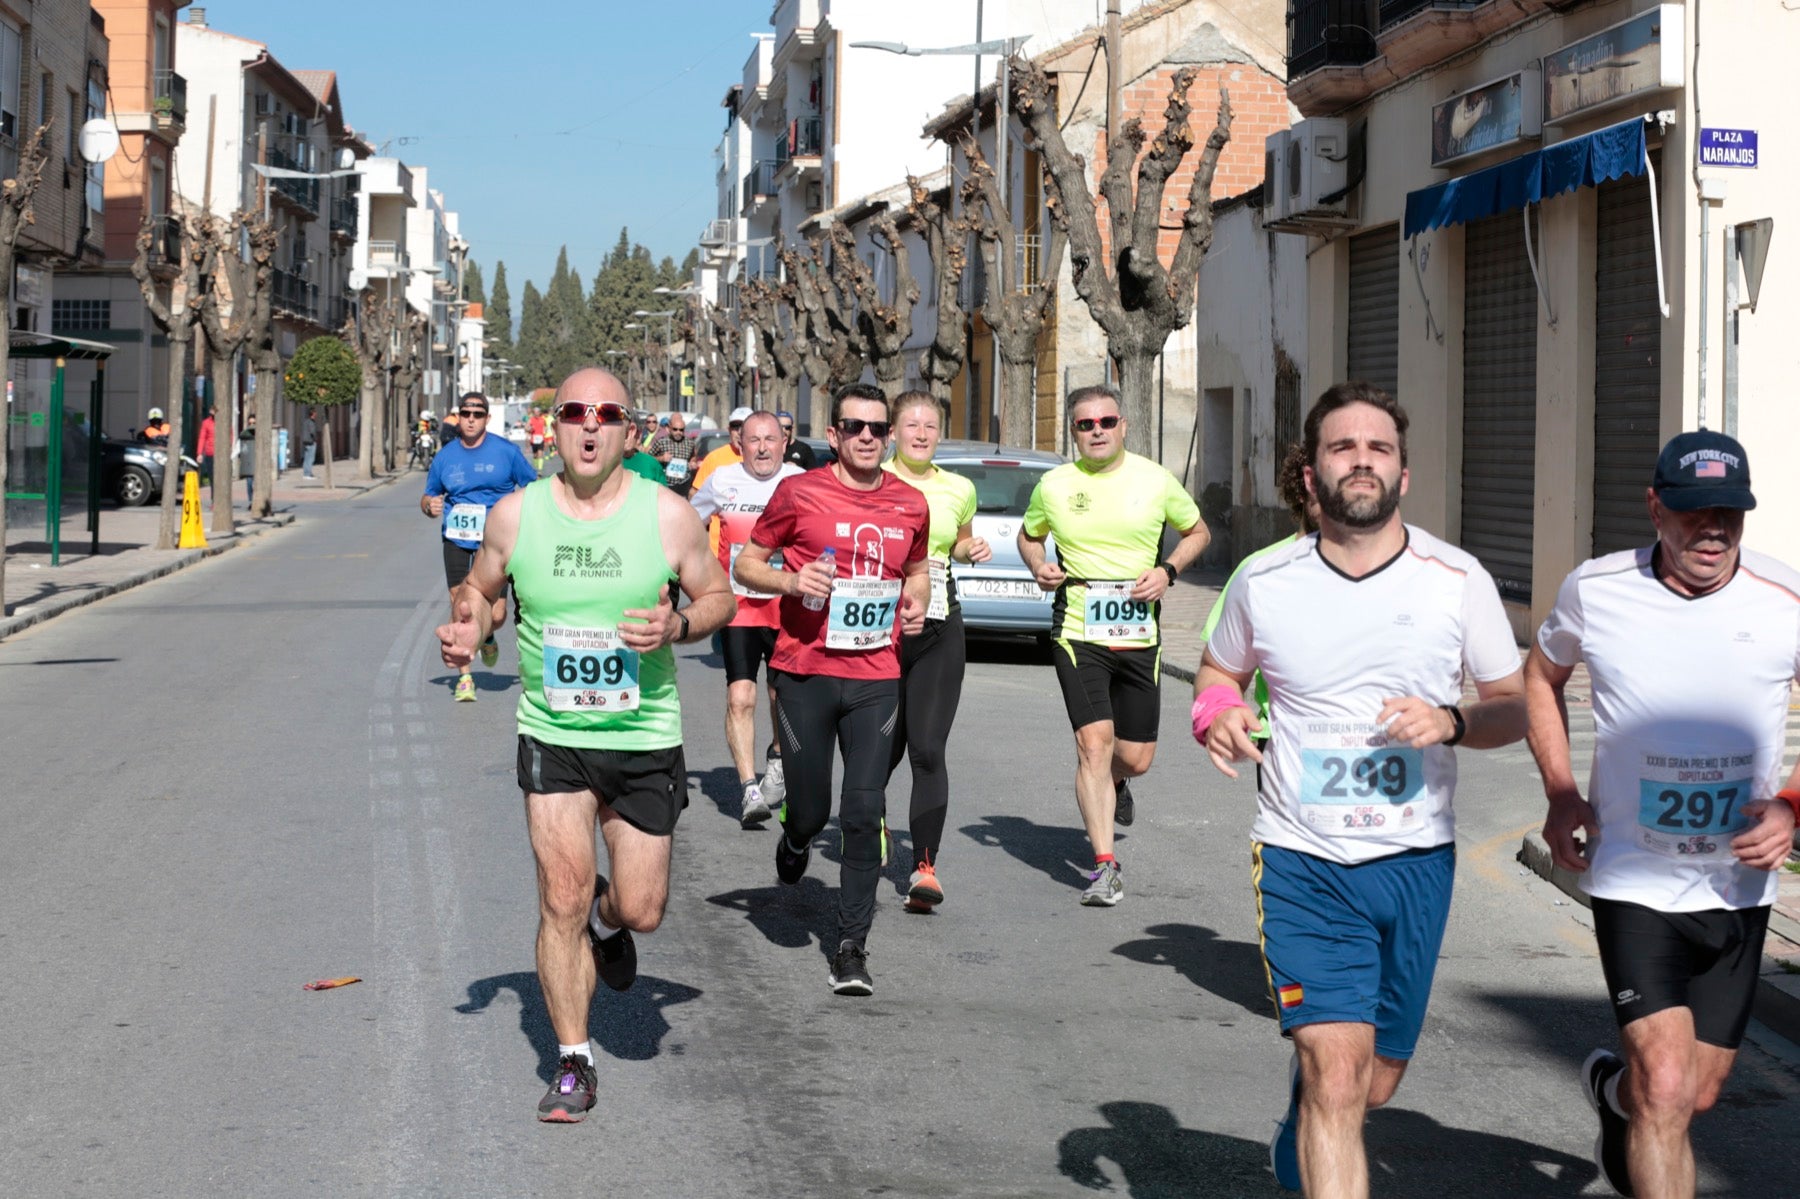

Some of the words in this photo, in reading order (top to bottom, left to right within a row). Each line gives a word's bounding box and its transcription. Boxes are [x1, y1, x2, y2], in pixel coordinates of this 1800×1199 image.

[1712, 131, 1743, 143] PLAZA
[1703, 147, 1755, 164] NARANJOS
[1679, 452, 1697, 469] NEW
[1698, 449, 1721, 460] YORK
[1720, 452, 1740, 469] CITY
[453, 514, 477, 529] 151
[554, 545, 622, 569] FILA
[553, 569, 565, 577] BE
[581, 570, 622, 578] RUNNER
[976, 580, 1009, 593] 7023
[1014, 582, 1038, 595] FNL
[843, 602, 891, 627] 867
[1091, 600, 1148, 621] 1099
[565, 628, 580, 638] GRAN
[582, 630, 604, 639] PREMIO
[605, 631, 613, 639] DE
[557, 654, 624, 685] 699
[1330, 722, 1351, 734] GRAN
[1668, 757, 1689, 769] GRAN
[1690, 758, 1718, 769] PREMIO
[1720, 757, 1729, 768] DE
[1320, 755, 1406, 797] 299
[1657, 788, 1738, 829] 297
